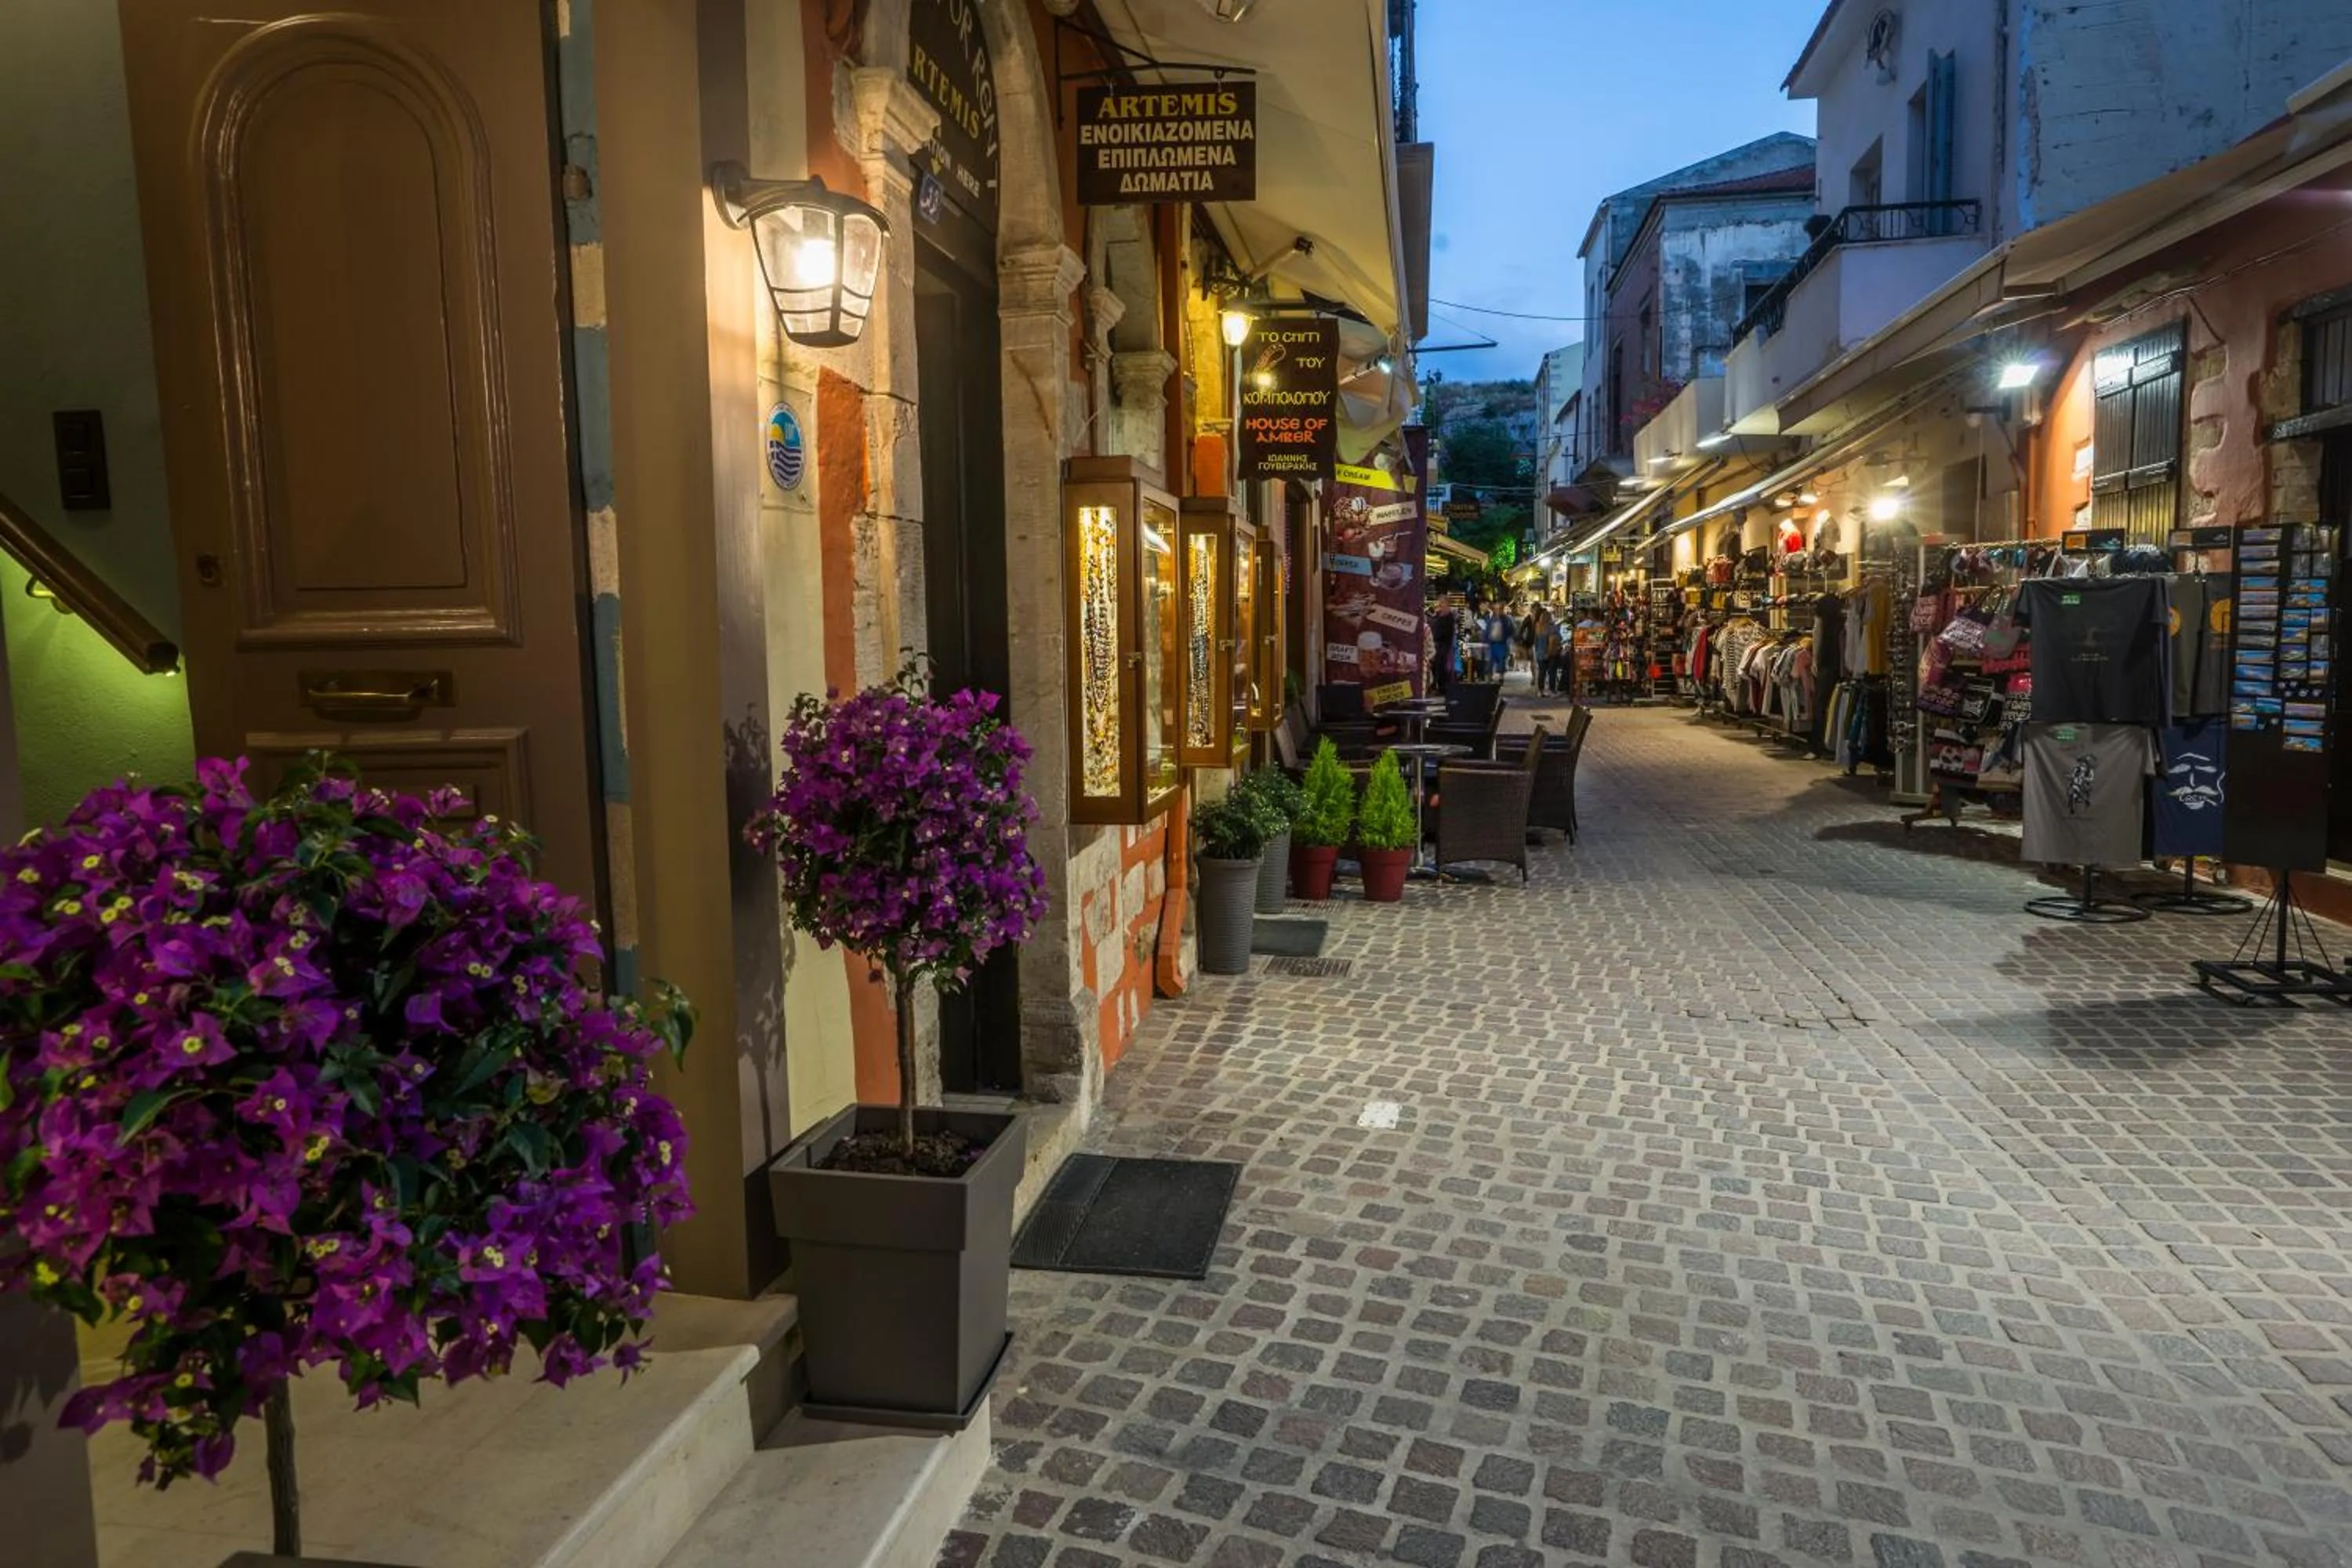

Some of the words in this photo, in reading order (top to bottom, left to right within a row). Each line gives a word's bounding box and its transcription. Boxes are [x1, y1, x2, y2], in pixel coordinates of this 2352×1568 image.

[913, 42, 979, 139] RTEMIS
[1098, 93, 1238, 118] ARTEMIS
[1080, 120, 1254, 145] ΕΝΟΙΚΙΑΖΟΜΕΝΑ
[1098, 146, 1236, 169] ΕΠΙΠΛΩΜΕΝΑ
[1120, 170, 1214, 193] ΔΩΜΑΤΙΑ
[1258, 332, 1279, 343] ΤΟ
[1295, 357, 1326, 368] ΤΟΥ
[1245, 418, 1300, 430] HOUSE
[1304, 418, 1327, 430] OF
[1256, 430, 1316, 444] AMBER
